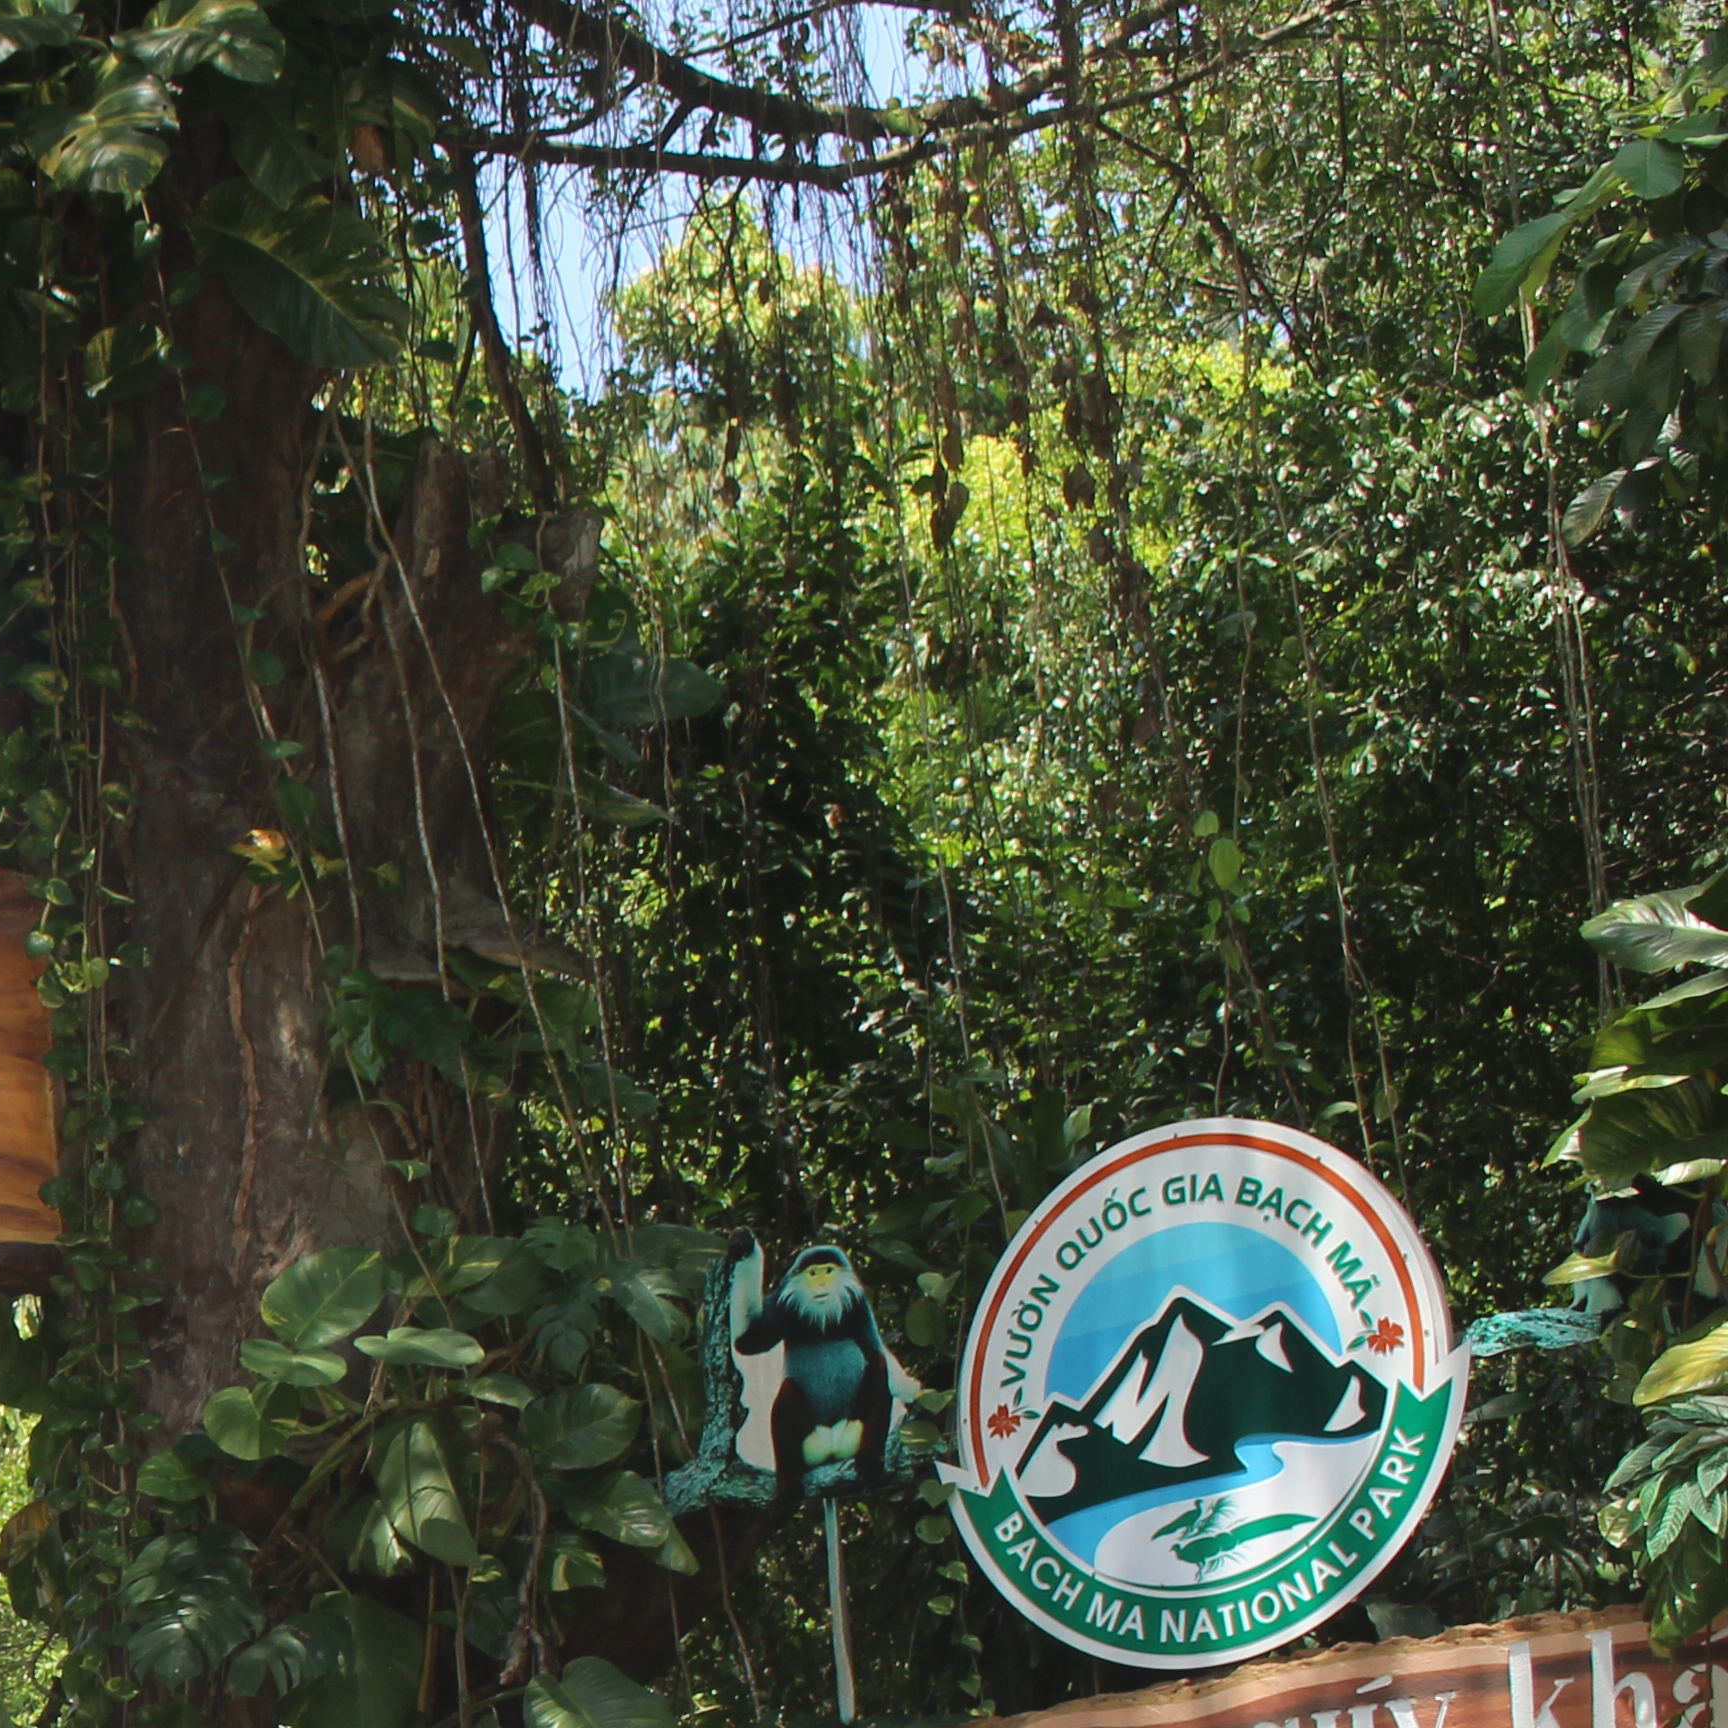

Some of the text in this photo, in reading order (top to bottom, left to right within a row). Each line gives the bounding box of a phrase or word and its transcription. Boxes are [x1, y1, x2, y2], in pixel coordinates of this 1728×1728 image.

[1000, 1172, 1381, 1388] VƯỜN QUỐC GIA BẠCH MÃ
[994, 1430, 1426, 1643] BACH MA NATIONAL PARK
